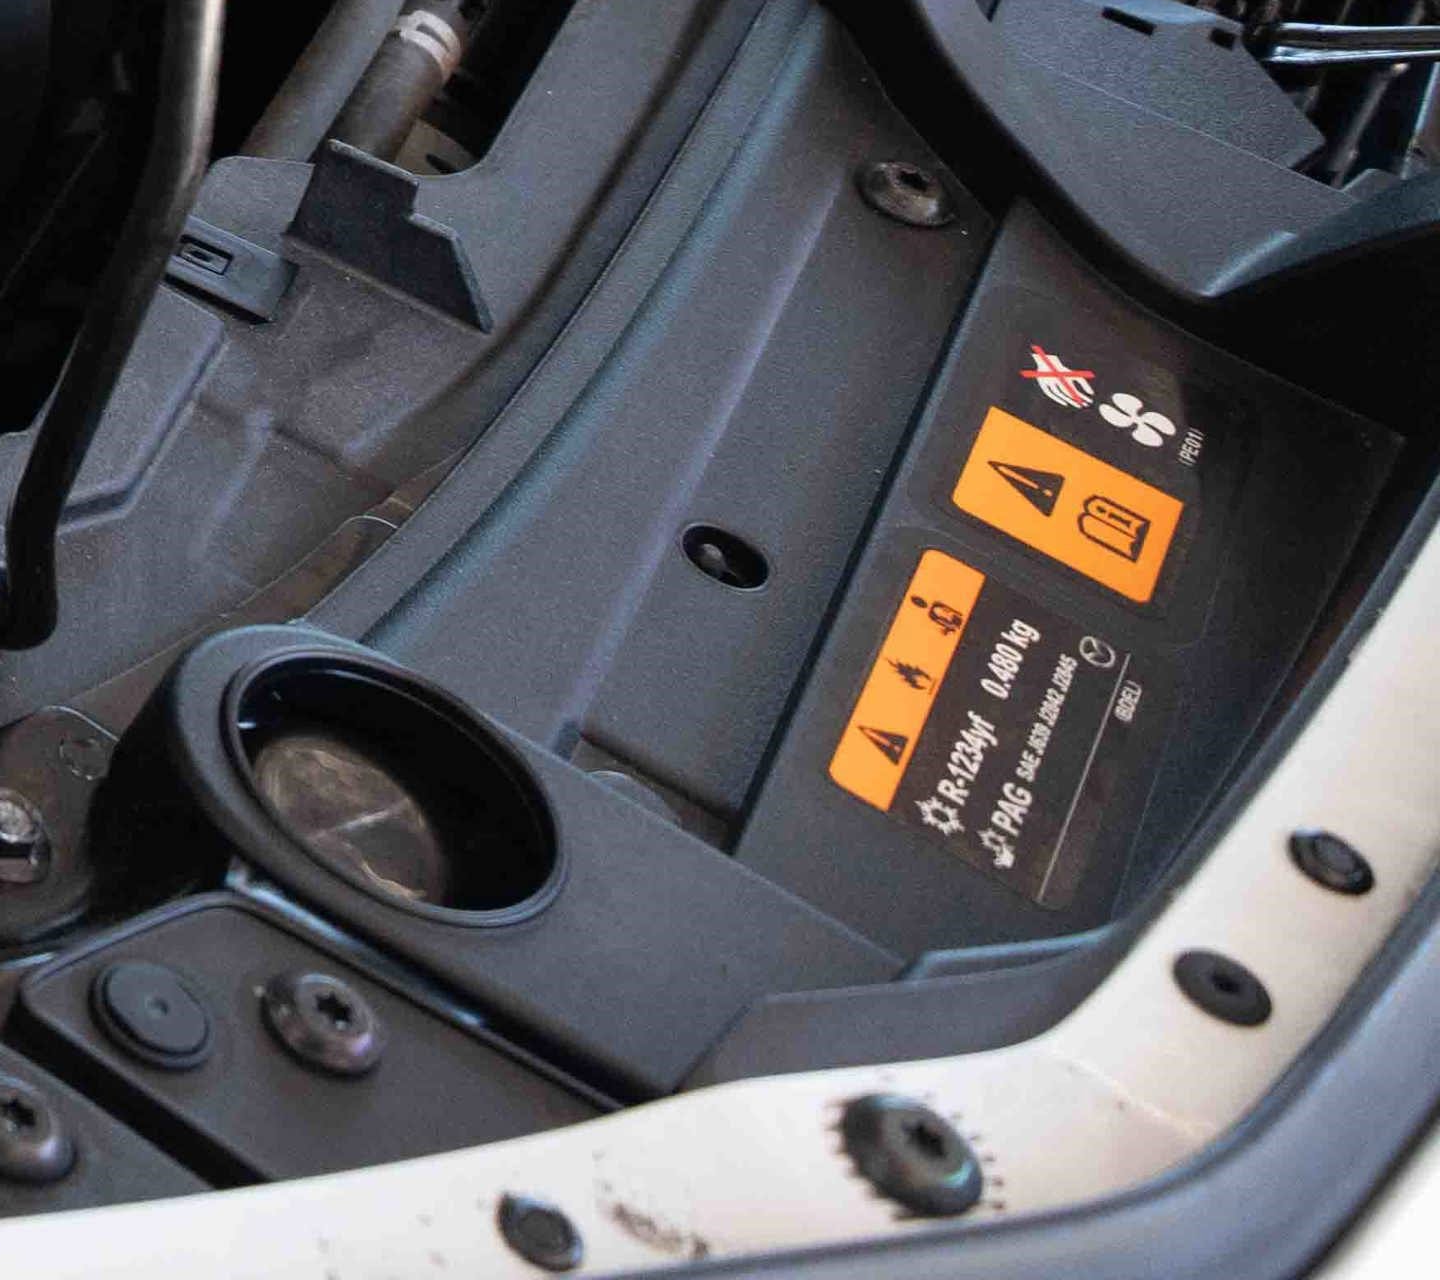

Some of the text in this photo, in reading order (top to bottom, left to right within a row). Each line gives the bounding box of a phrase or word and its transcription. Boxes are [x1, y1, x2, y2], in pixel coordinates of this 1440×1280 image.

[937, 618, 1041, 806] R-1234yf 0.480 kg
[991, 782, 1033, 837] PAG
[1015, 749, 1042, 782] SAE
